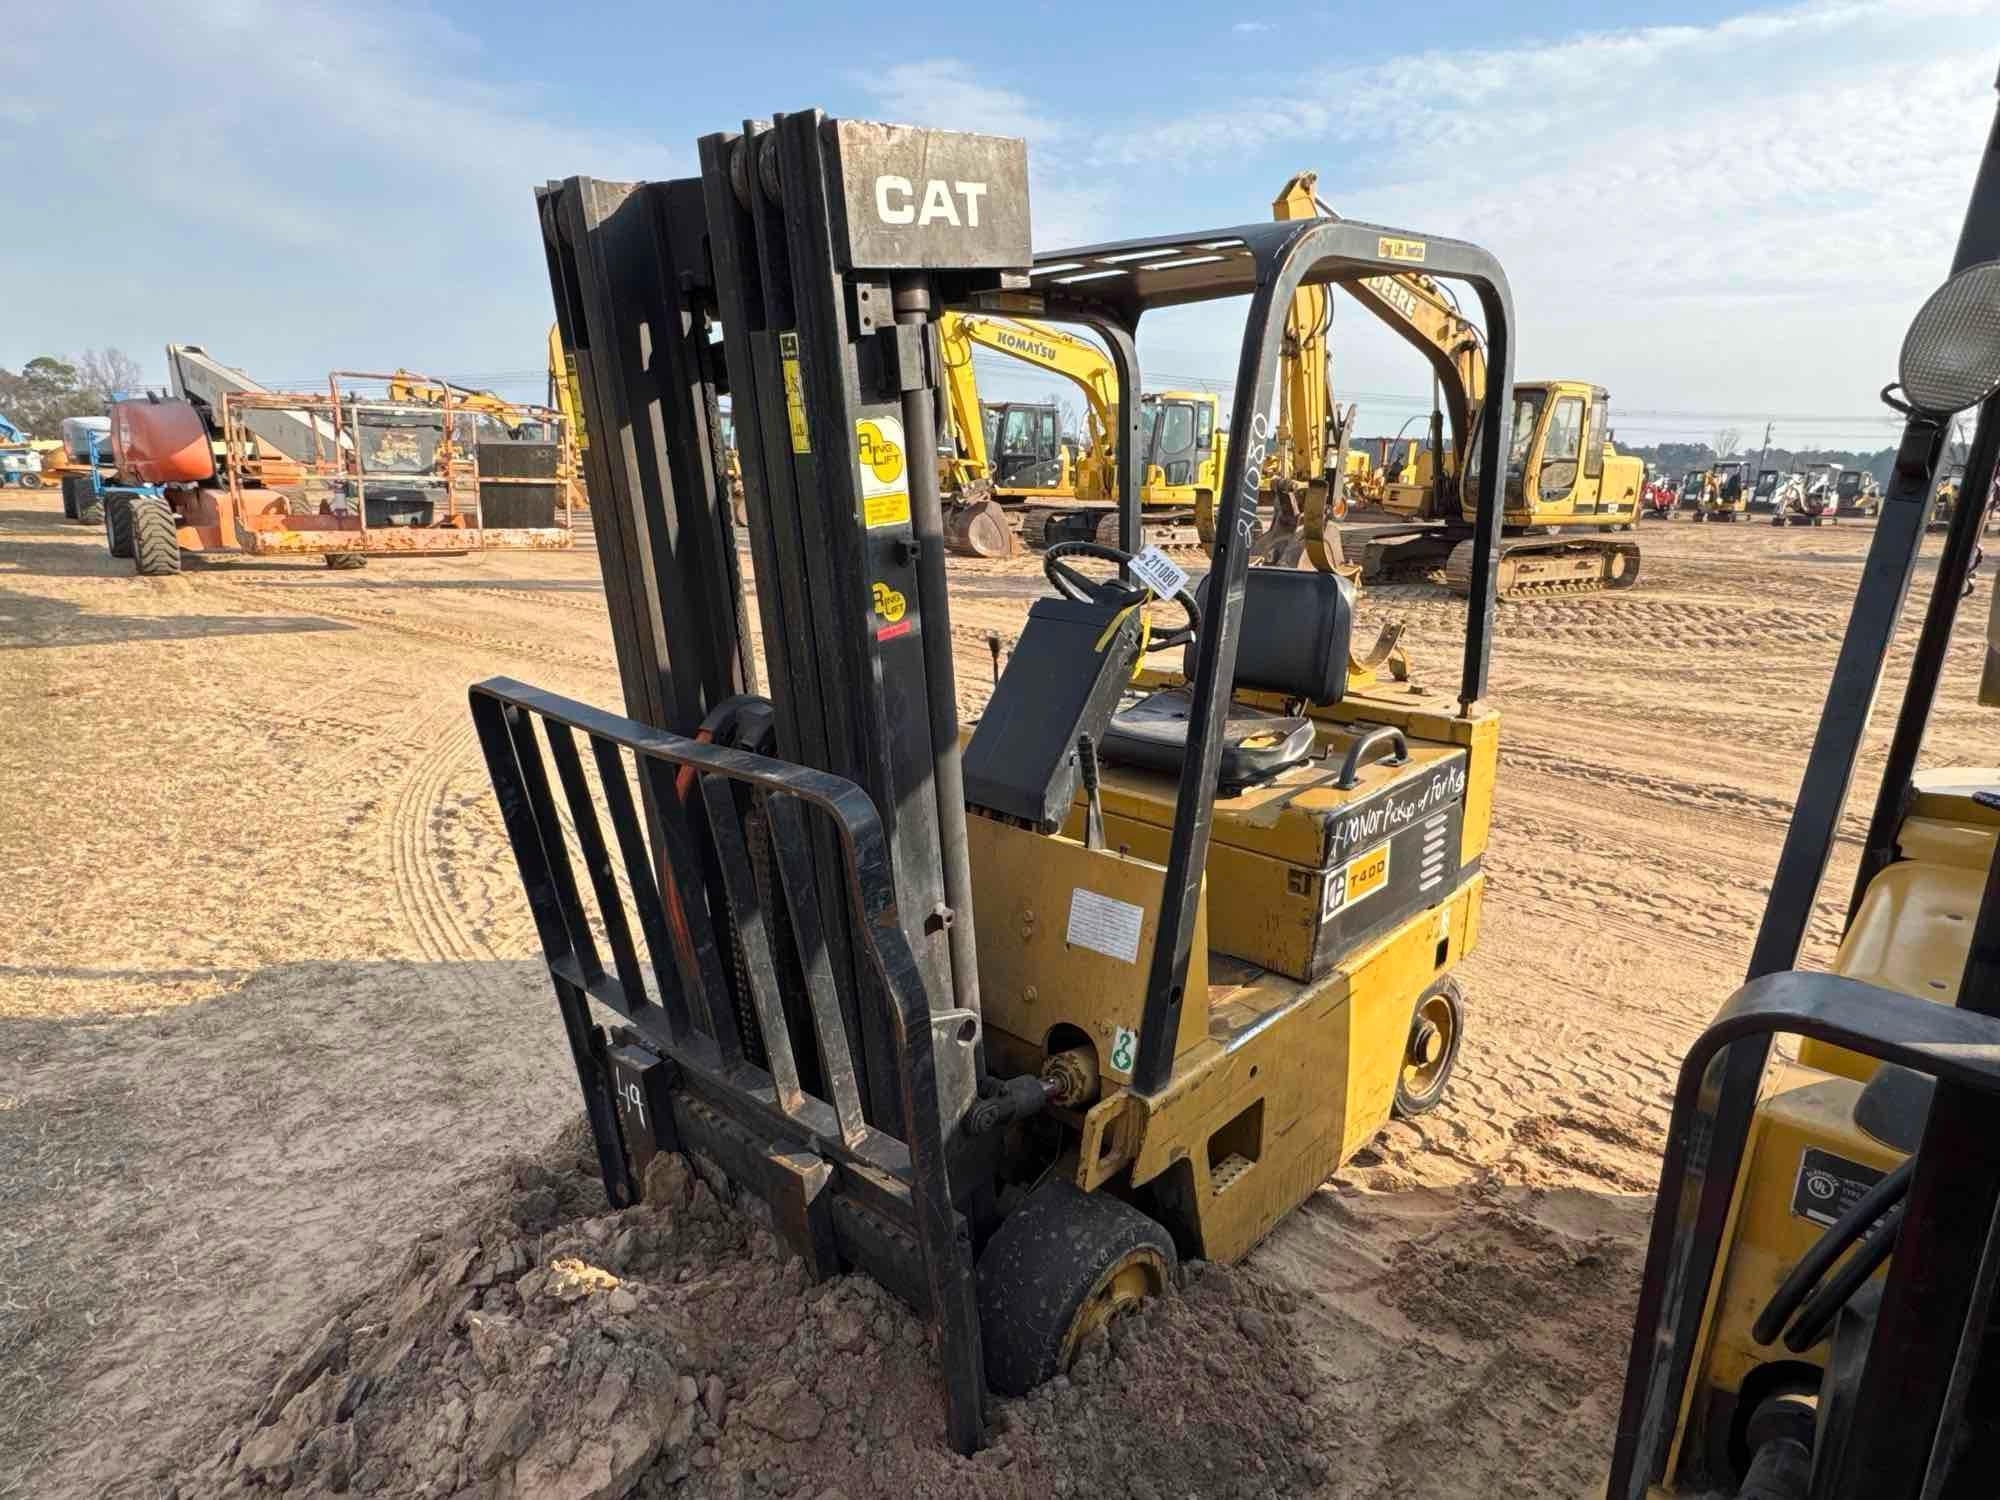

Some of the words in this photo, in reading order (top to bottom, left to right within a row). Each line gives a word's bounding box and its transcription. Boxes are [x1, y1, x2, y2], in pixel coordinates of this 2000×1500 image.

[875, 175, 987, 228] CAT
[1368, 276, 1417, 320] DEERE
[997, 331, 1057, 361] KOMATSU
[873, 445, 900, 467] LIFT
[1144, 554, 1180, 588] 211080
[615, 1065, 647, 1130] 49
